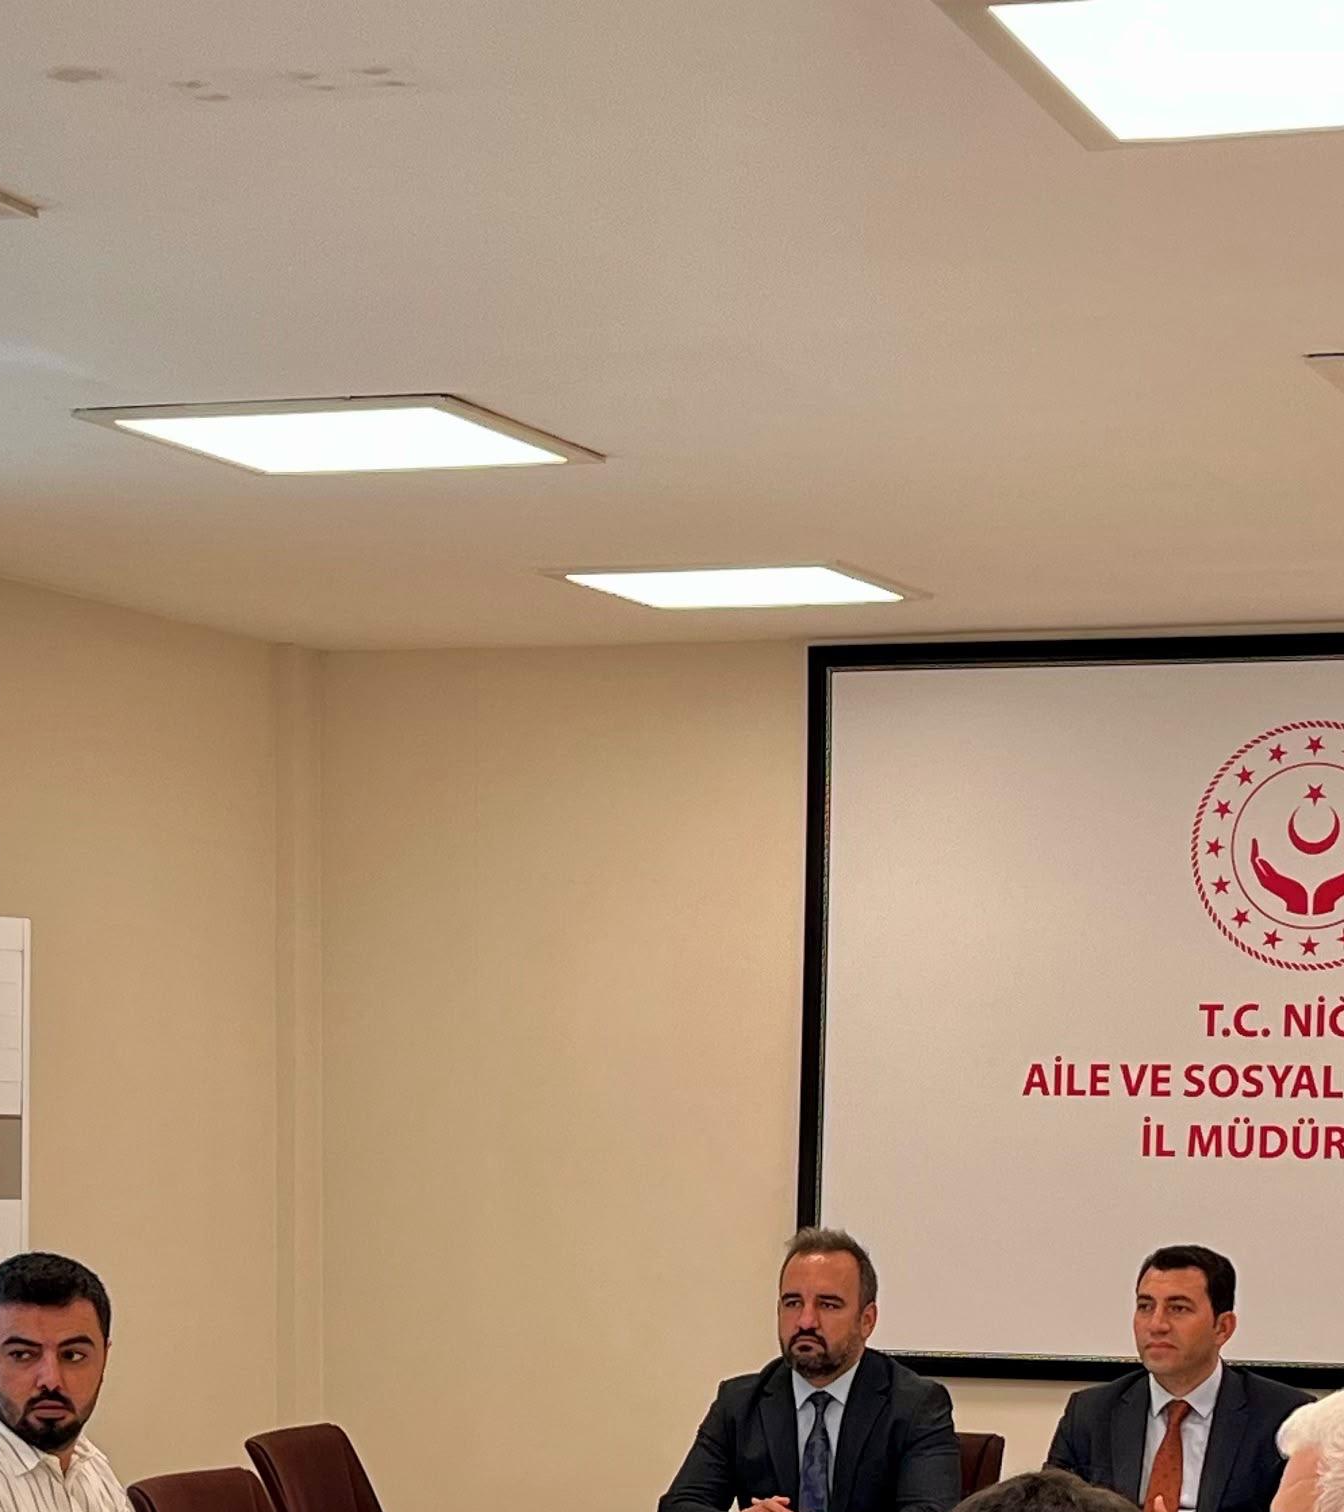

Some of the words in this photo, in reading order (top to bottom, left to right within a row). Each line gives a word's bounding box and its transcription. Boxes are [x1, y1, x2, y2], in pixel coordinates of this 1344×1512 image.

[1199, 1001, 1270, 1039] T.C.
[1022, 1056, 1110, 1098] AİLE
[1120, 1063, 1172, 1098] VE
[1183, 1063, 1344, 1100] SOSYAL
[1141, 1116, 1176, 1159] İL
